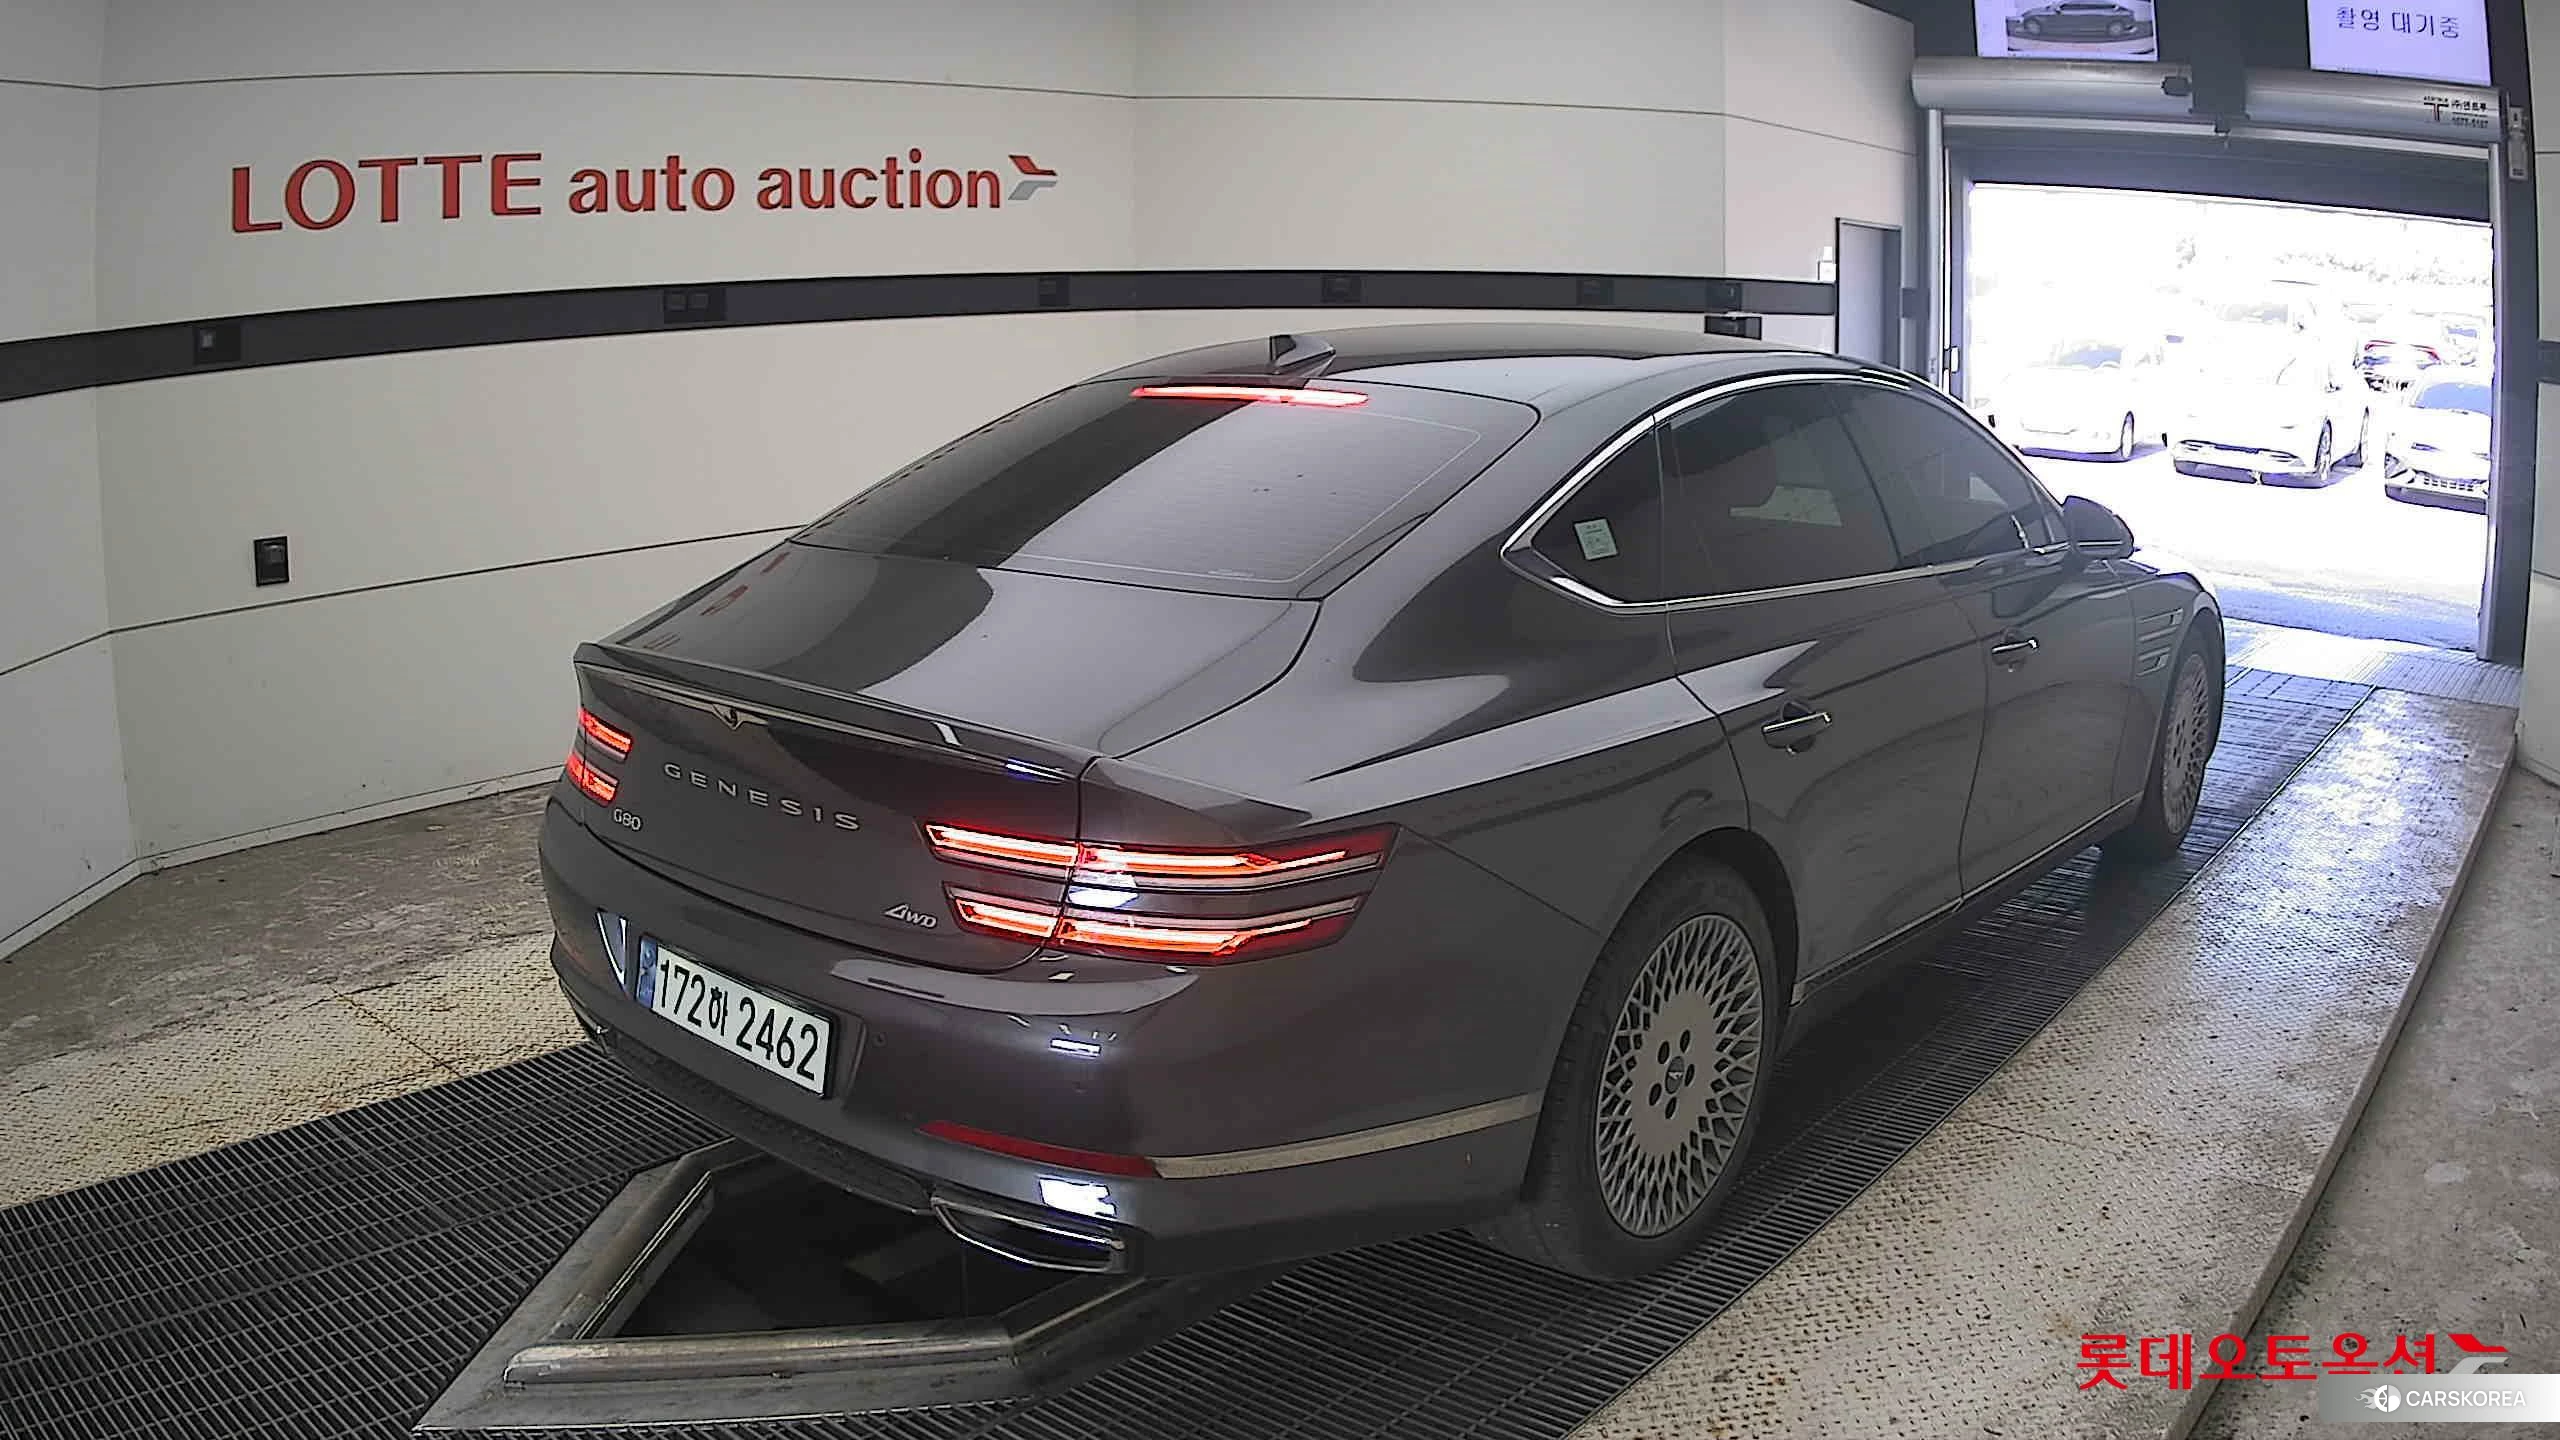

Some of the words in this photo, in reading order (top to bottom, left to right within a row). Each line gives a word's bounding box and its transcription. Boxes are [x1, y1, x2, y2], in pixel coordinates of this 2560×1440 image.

[2337, 6, 2380, 31] 촬영
[2391, 11, 2459, 39] 대기중
[232, 153, 542, 233] LOTTE
[568, 155, 736, 213] auto
[757, 148, 1001, 210] auction
[613, 807, 642, 831] G80
[663, 762, 860, 831] GENESIS
[659, 959, 729, 1037] 172하
[736, 996, 819, 1081] 2462
